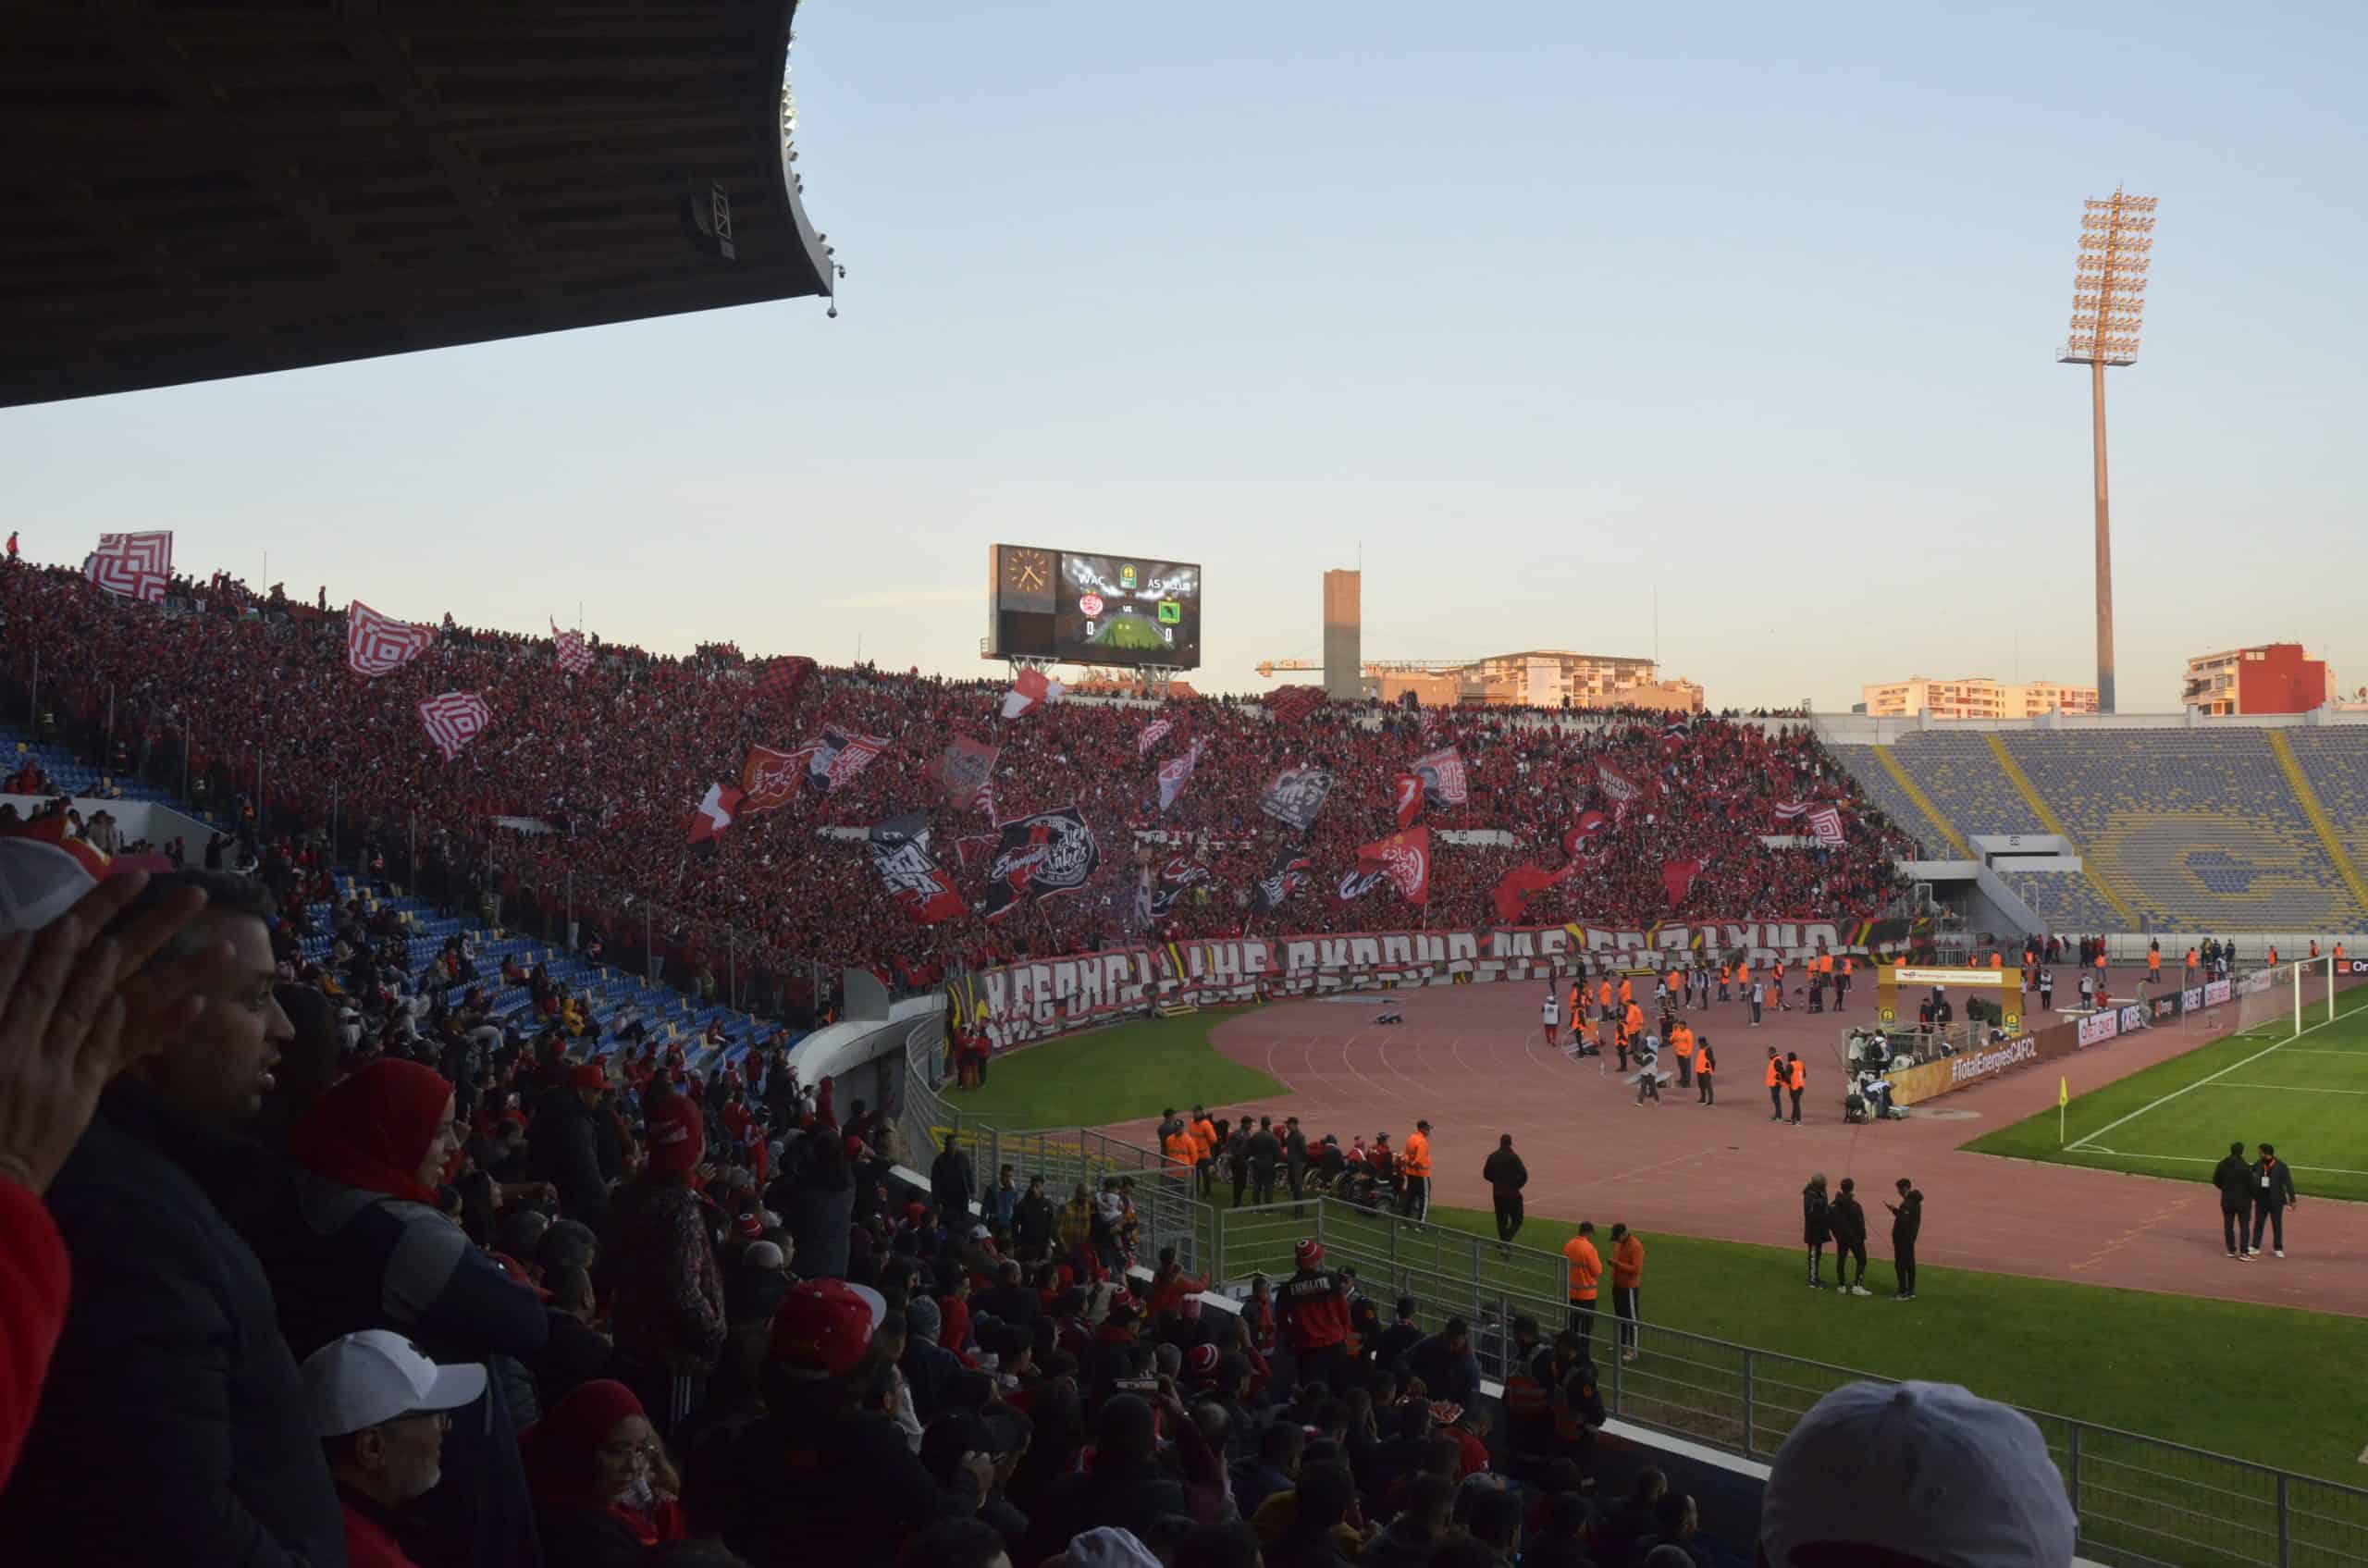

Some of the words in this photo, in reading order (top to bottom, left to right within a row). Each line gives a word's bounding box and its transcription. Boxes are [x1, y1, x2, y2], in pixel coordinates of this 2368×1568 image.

[1078, 575, 1105, 586] WAC
[1148, 577, 1161, 588] AS
[1086, 621, 1094, 636] 0
[1165, 628, 1172, 642] 0
[1951, 1036, 2038, 1081] #TotalEnergiesCAFCL
